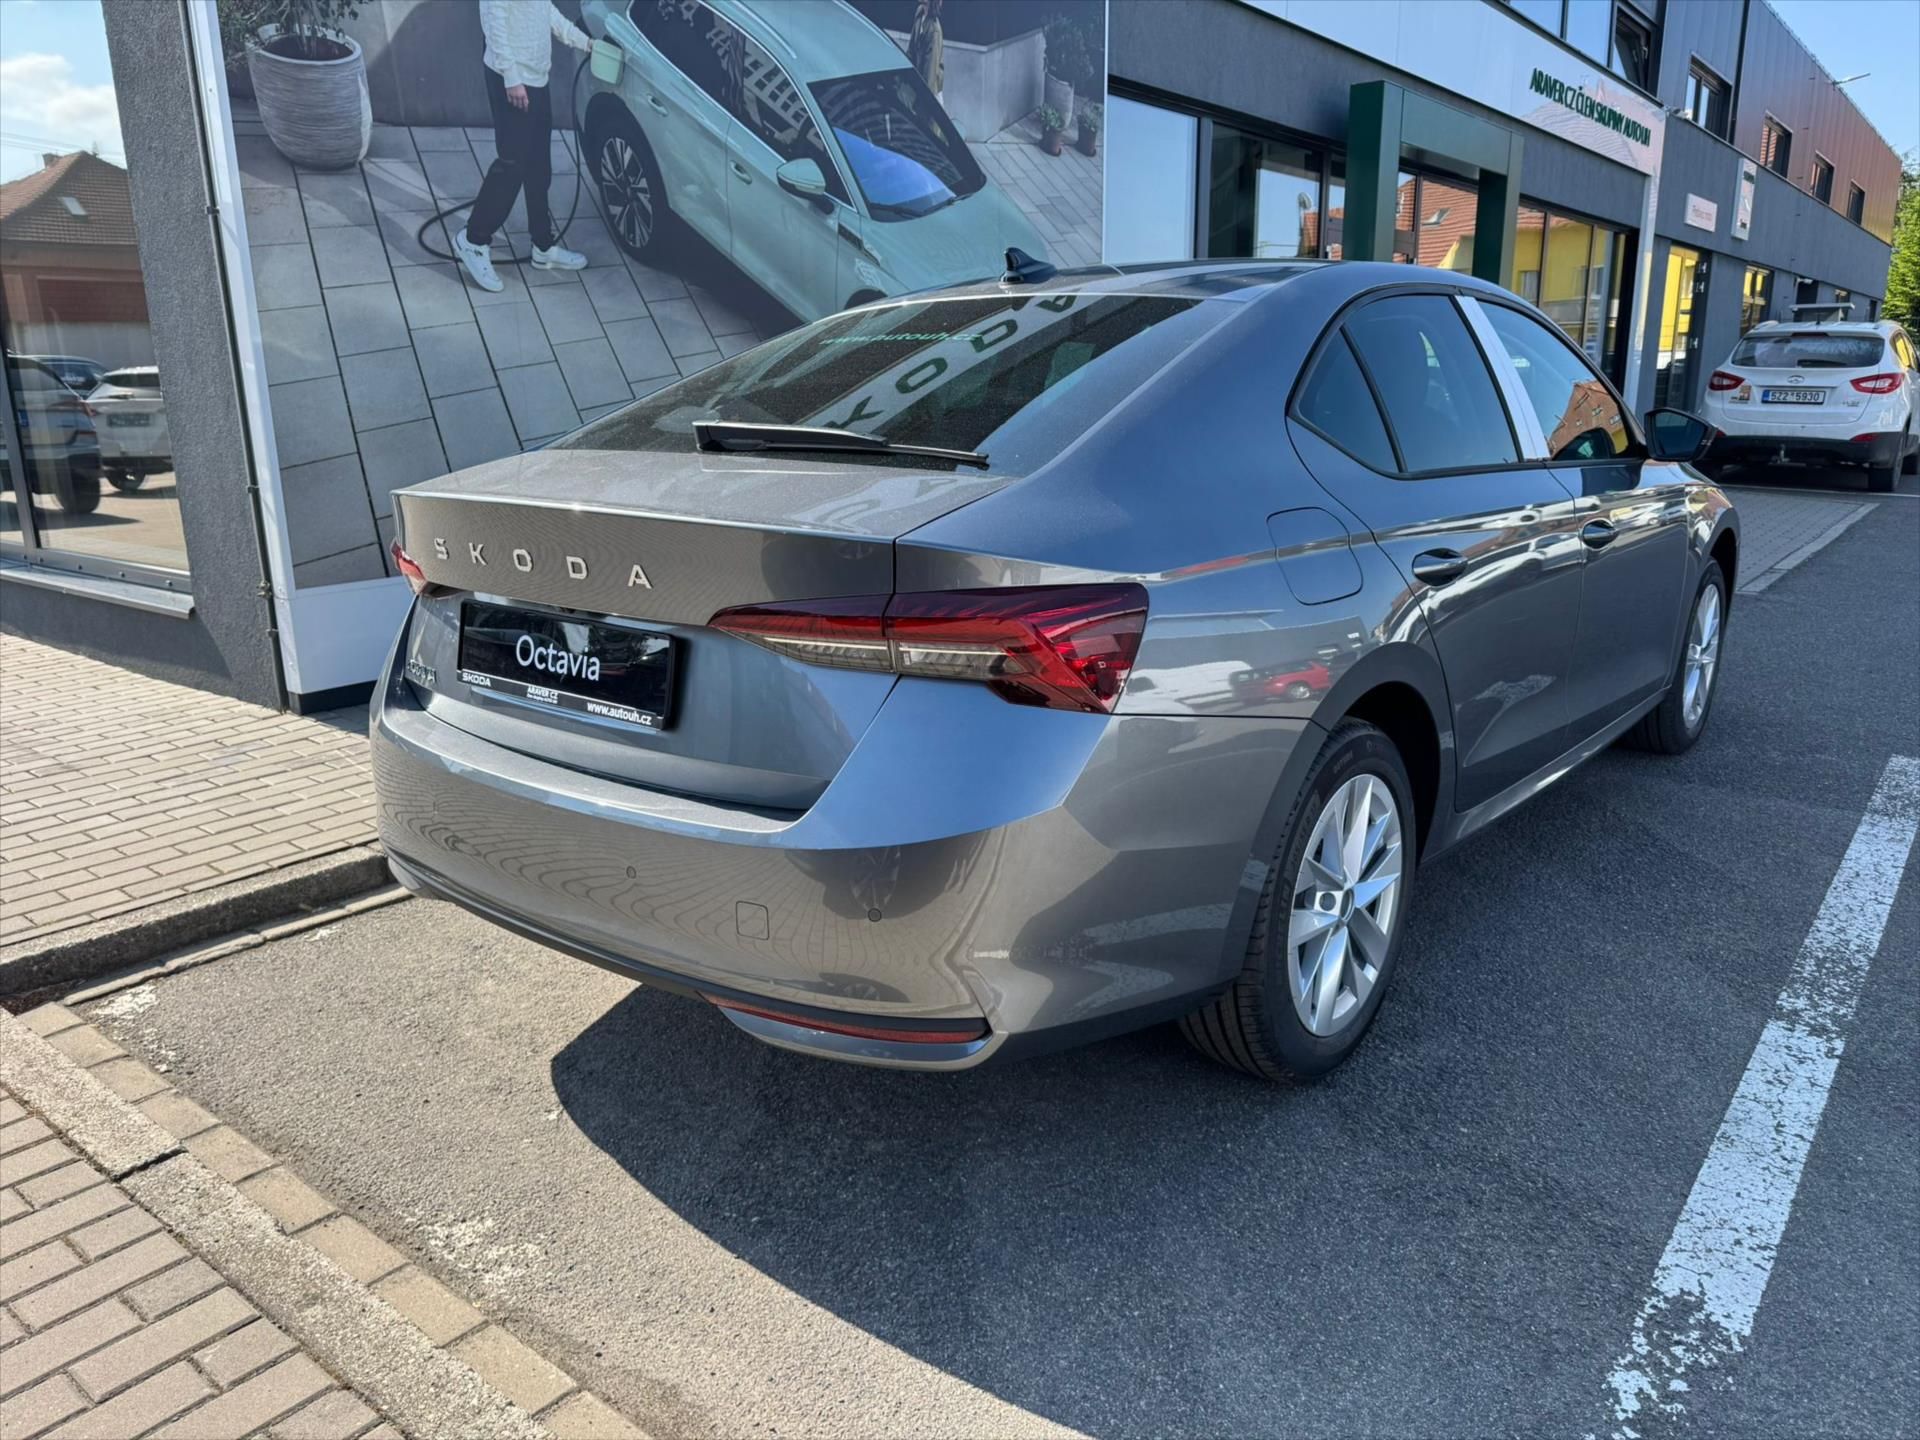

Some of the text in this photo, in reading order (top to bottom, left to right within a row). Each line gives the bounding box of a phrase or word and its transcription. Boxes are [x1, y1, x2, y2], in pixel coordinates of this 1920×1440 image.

[1529, 67, 1564, 105] ARAVER
[1565, 86, 1576, 110] CZ
[1795, 391, 1819, 402] 5930
[515, 634, 601, 681] Octavia
[527, 685, 549, 698] ARAVER
[550, 690, 559, 700] CZ
[587, 702, 652, 726] www.autouh.cz
